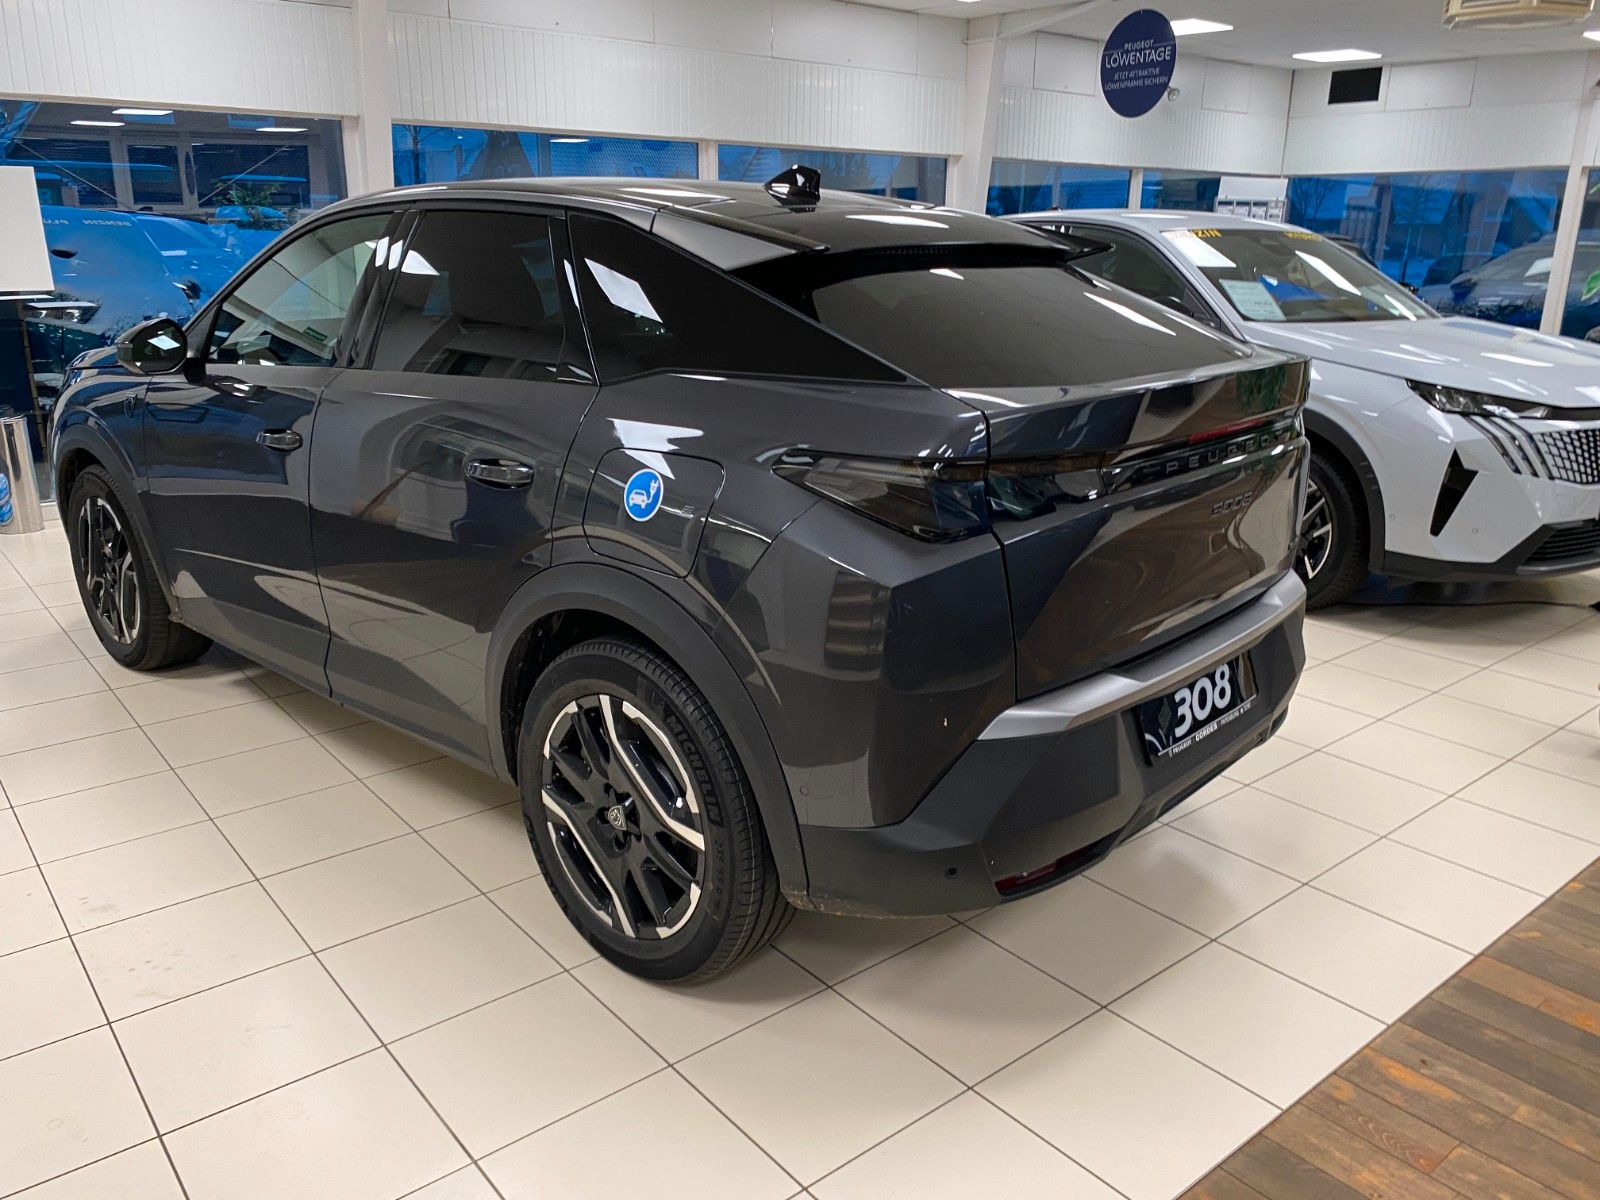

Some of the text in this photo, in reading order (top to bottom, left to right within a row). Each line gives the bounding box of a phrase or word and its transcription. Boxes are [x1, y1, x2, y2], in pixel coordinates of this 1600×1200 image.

[1124, 39, 1154, 50] PEUGEOT
[1105, 47, 1171, 68] LÖWENTAGE
[1165, 429, 1284, 474] PEUGEOT
[1174, 663, 1232, 738] 308
[1195, 722, 1218, 742] CORDES
